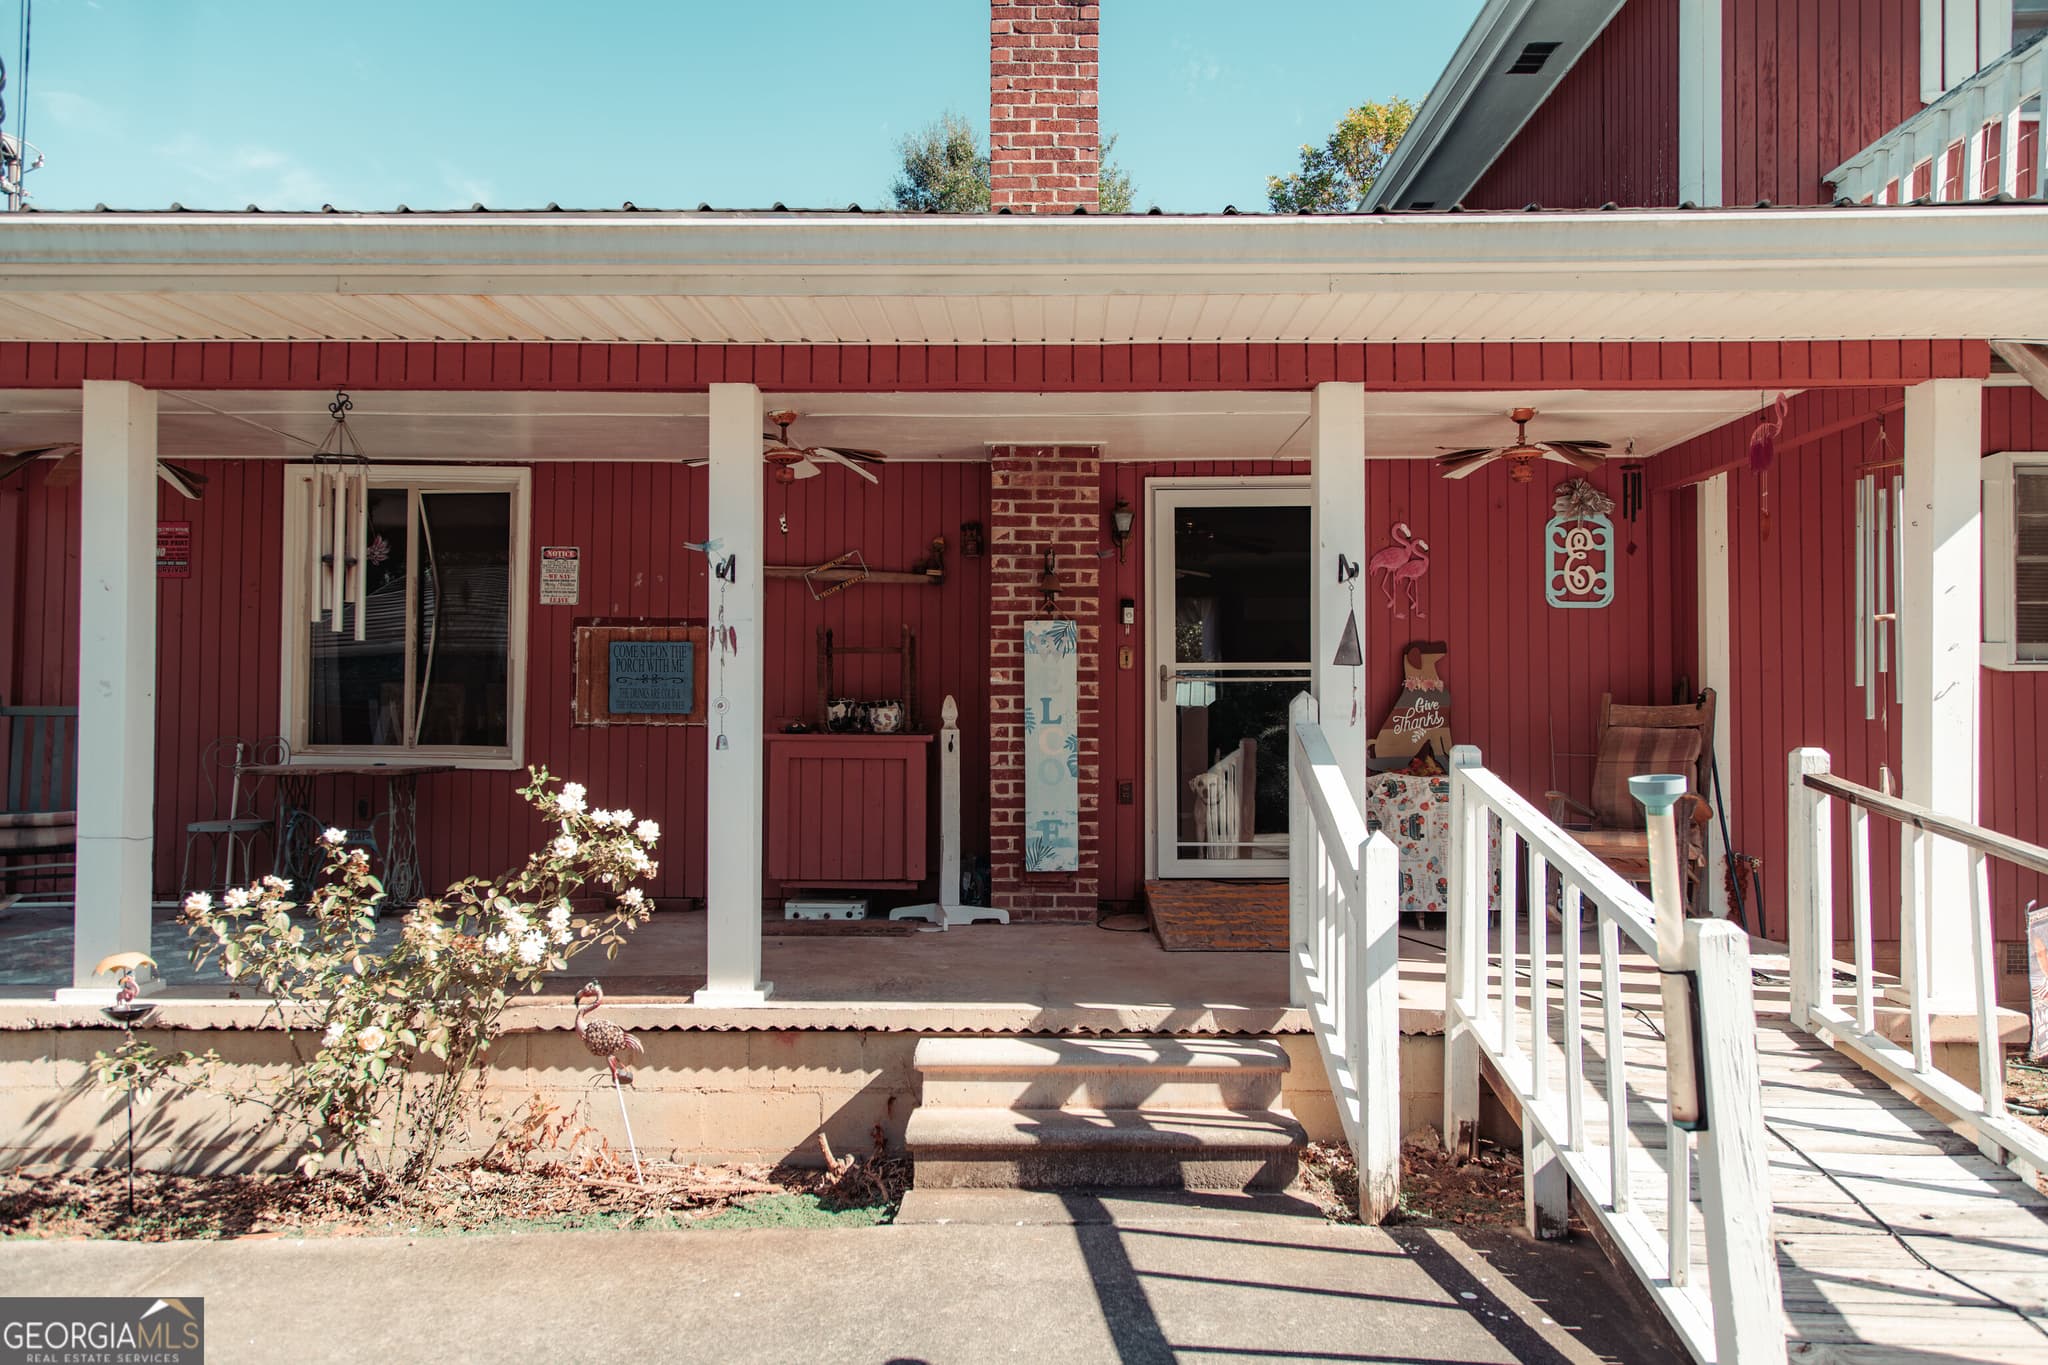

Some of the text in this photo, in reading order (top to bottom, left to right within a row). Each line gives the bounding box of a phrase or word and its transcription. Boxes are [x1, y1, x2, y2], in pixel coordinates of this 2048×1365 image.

[549, 550, 574, 558] NOTICE
[613, 645, 688, 658] COME SIT ON THE
[616, 659, 685, 672] PORCH WITH ME
[1414, 697, 1441, 713] Give
[1392, 707, 1445, 734] Thanks
